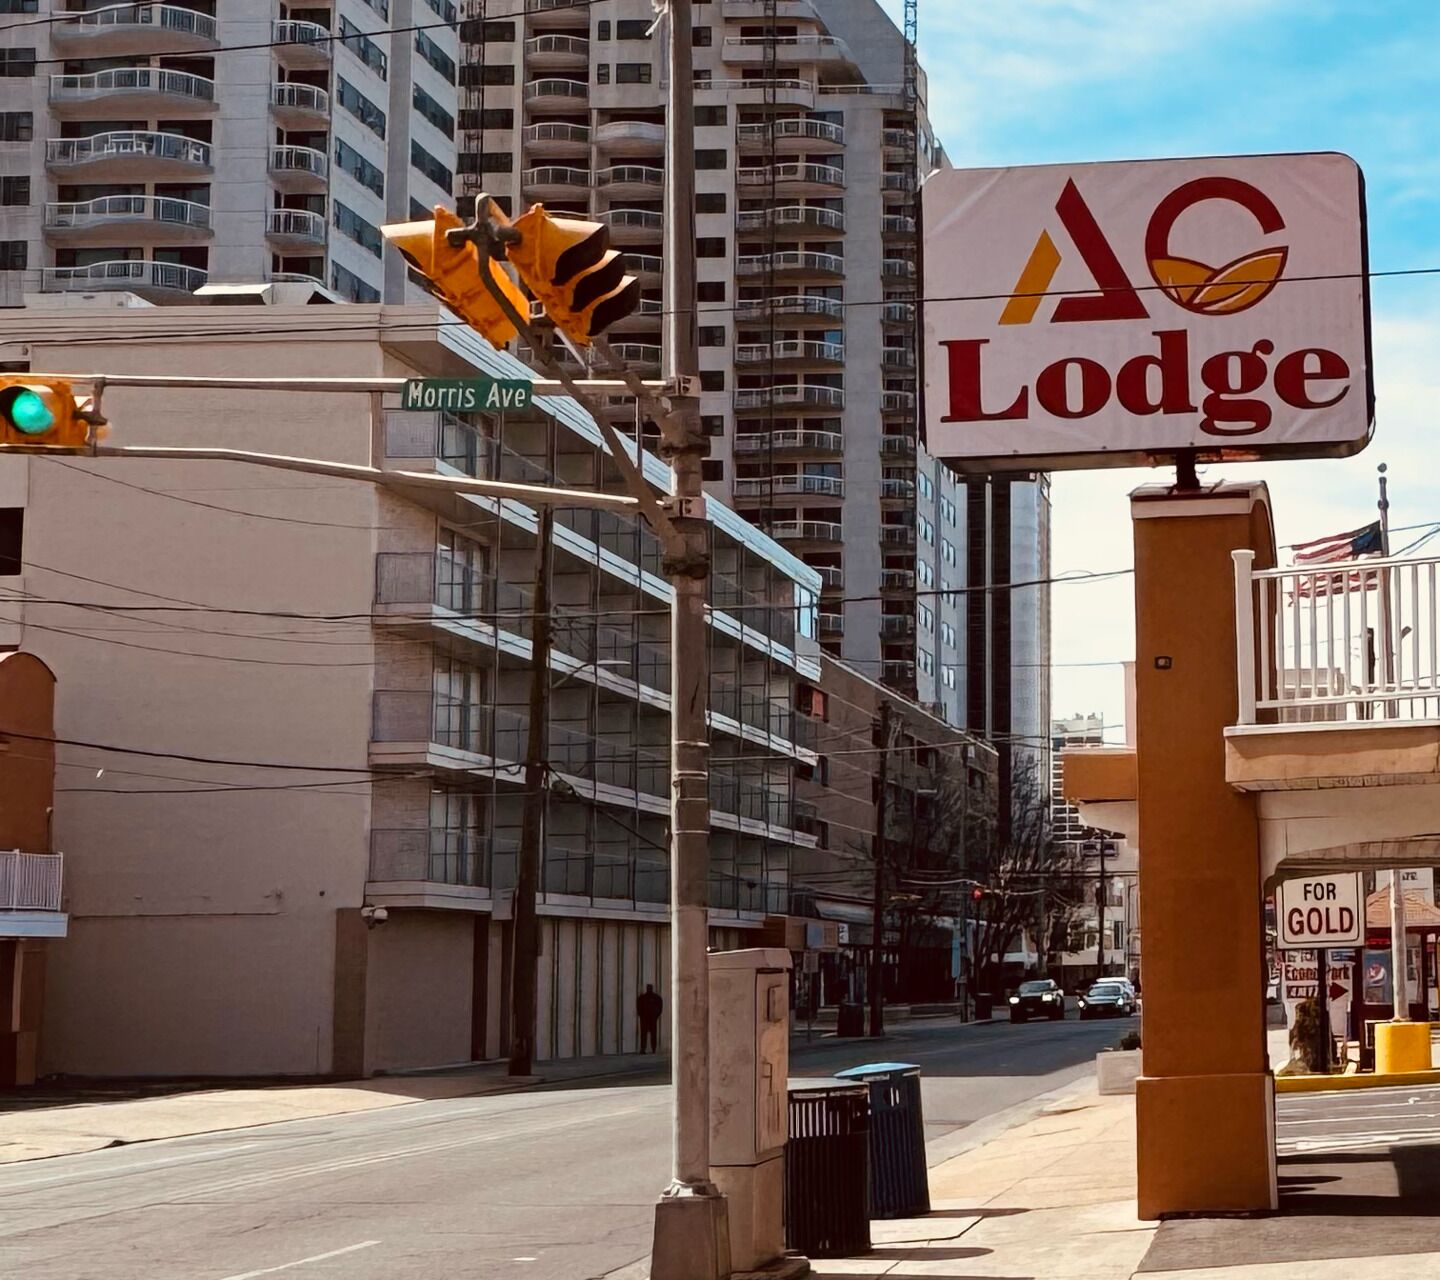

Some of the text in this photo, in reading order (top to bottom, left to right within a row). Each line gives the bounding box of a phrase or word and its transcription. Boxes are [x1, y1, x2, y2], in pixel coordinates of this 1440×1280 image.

[408, 381, 526, 408] Morris Ave
[939, 329, 1351, 436] Lodge
[1303, 882, 1337, 902] FOR
[1288, 906, 1354, 936] GOLD
